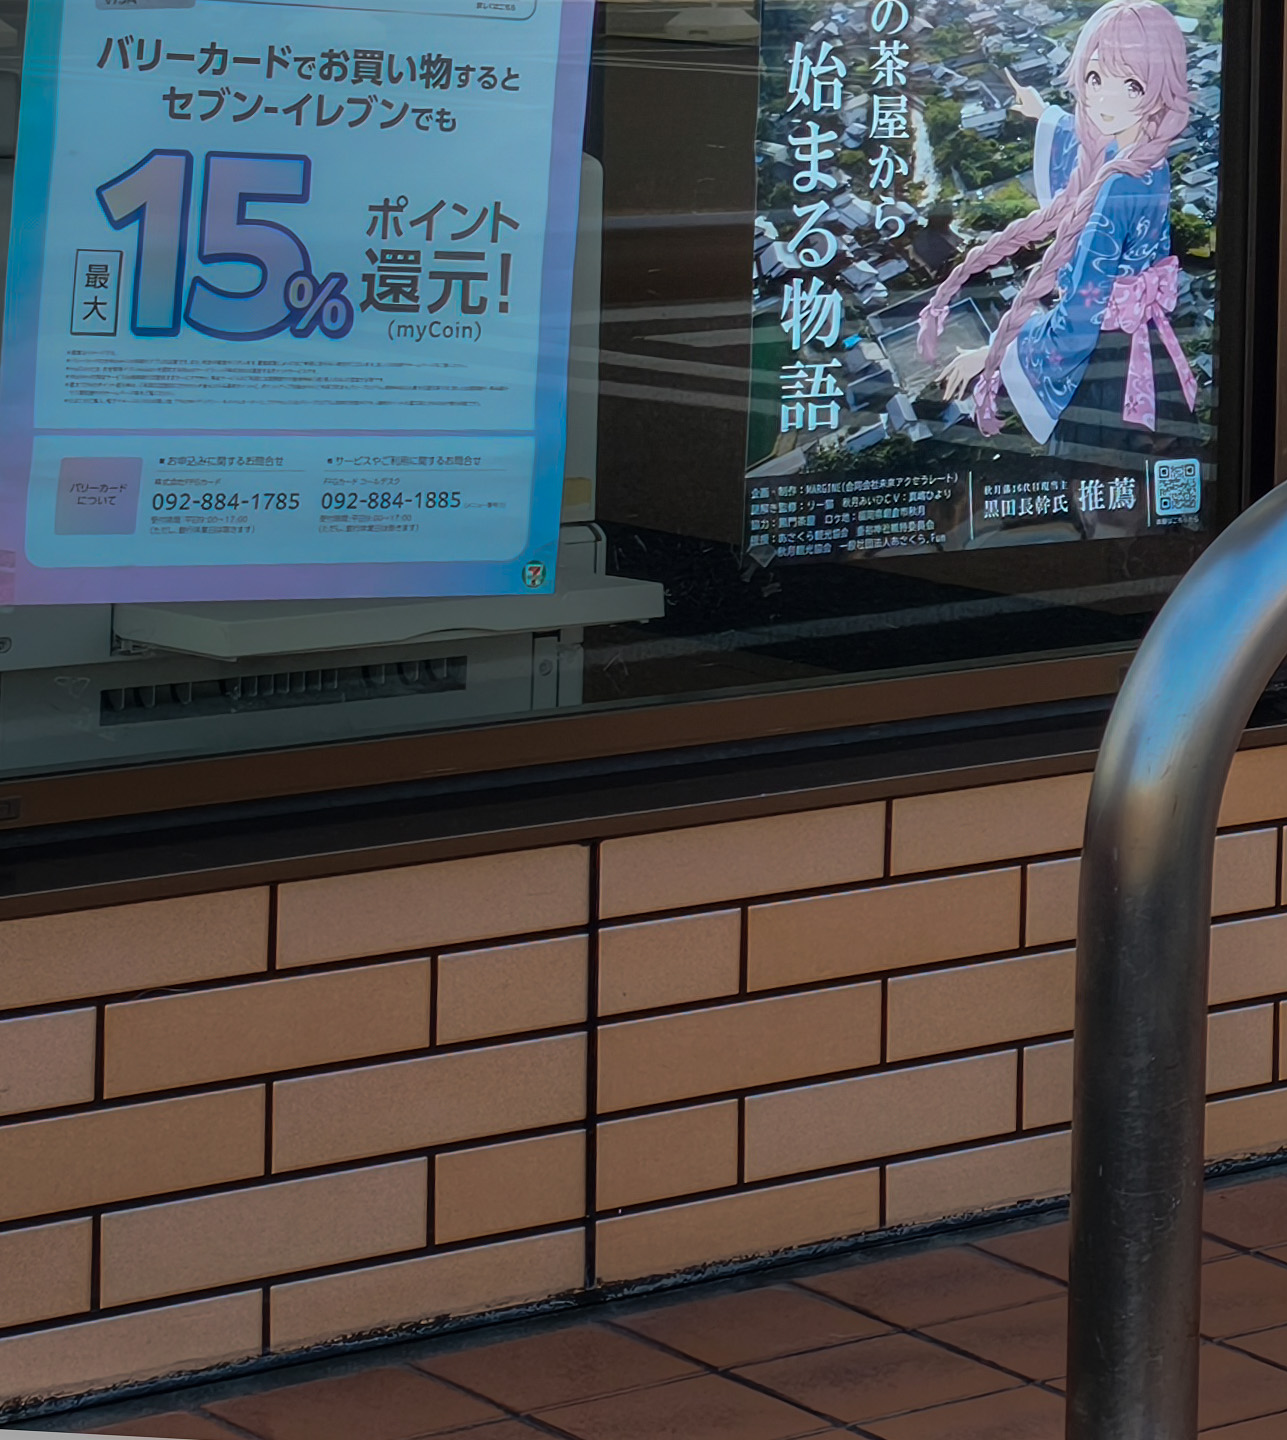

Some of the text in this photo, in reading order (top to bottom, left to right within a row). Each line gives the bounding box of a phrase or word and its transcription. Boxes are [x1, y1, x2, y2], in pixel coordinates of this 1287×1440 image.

[97, 35, 521, 93] バリーカードでお買い物すると
[162, 87, 458, 133] セブン-イレブンでも
[365, 194, 521, 243] ポイント
[779, 40, 848, 434] 始まる物語
[96, 148, 356, 342] 15%
[81, 262, 113, 323] 最大
[360, 247, 513, 315] 還元!
[387, 319, 483, 343] (myCoin)
[152, 492, 301, 512] 092-884-1785
[320, 491, 462, 511] 092-884-1885
[1078, 477, 1138, 512] 推薦
